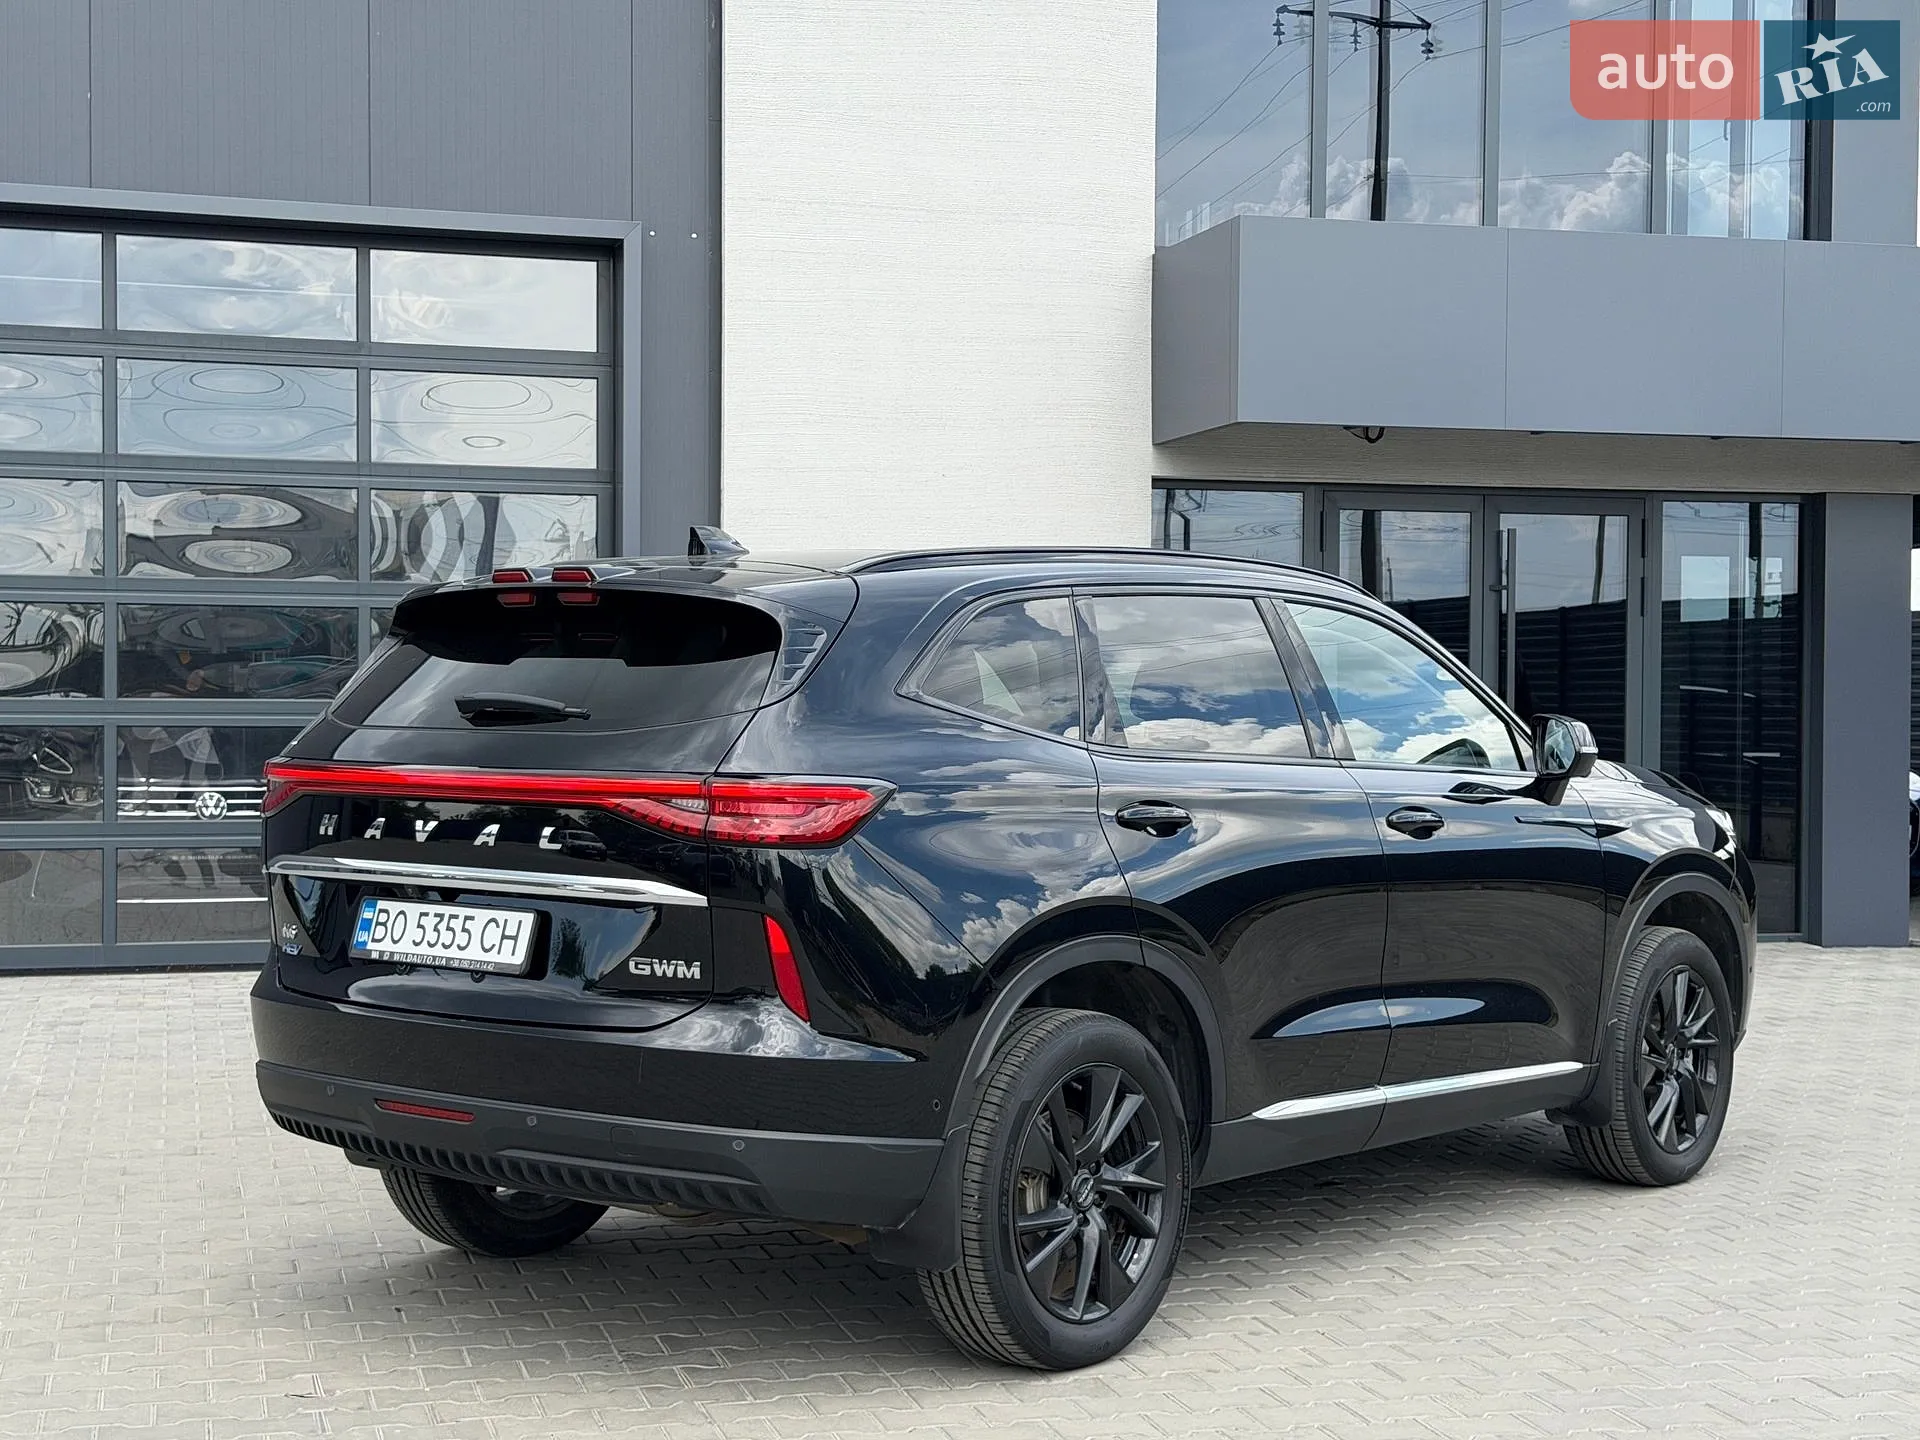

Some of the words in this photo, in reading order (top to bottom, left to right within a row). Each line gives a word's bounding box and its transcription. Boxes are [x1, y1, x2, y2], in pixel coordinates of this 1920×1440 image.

[319, 813, 563, 850] HAVAL
[357, 930, 369, 942] UA
[370, 907, 408, 945] BO
[411, 911, 475, 951] 5355
[480, 917, 523, 957] CH
[393, 952, 446, 967] WILDAUTO.UA
[628, 957, 701, 980] GWM
